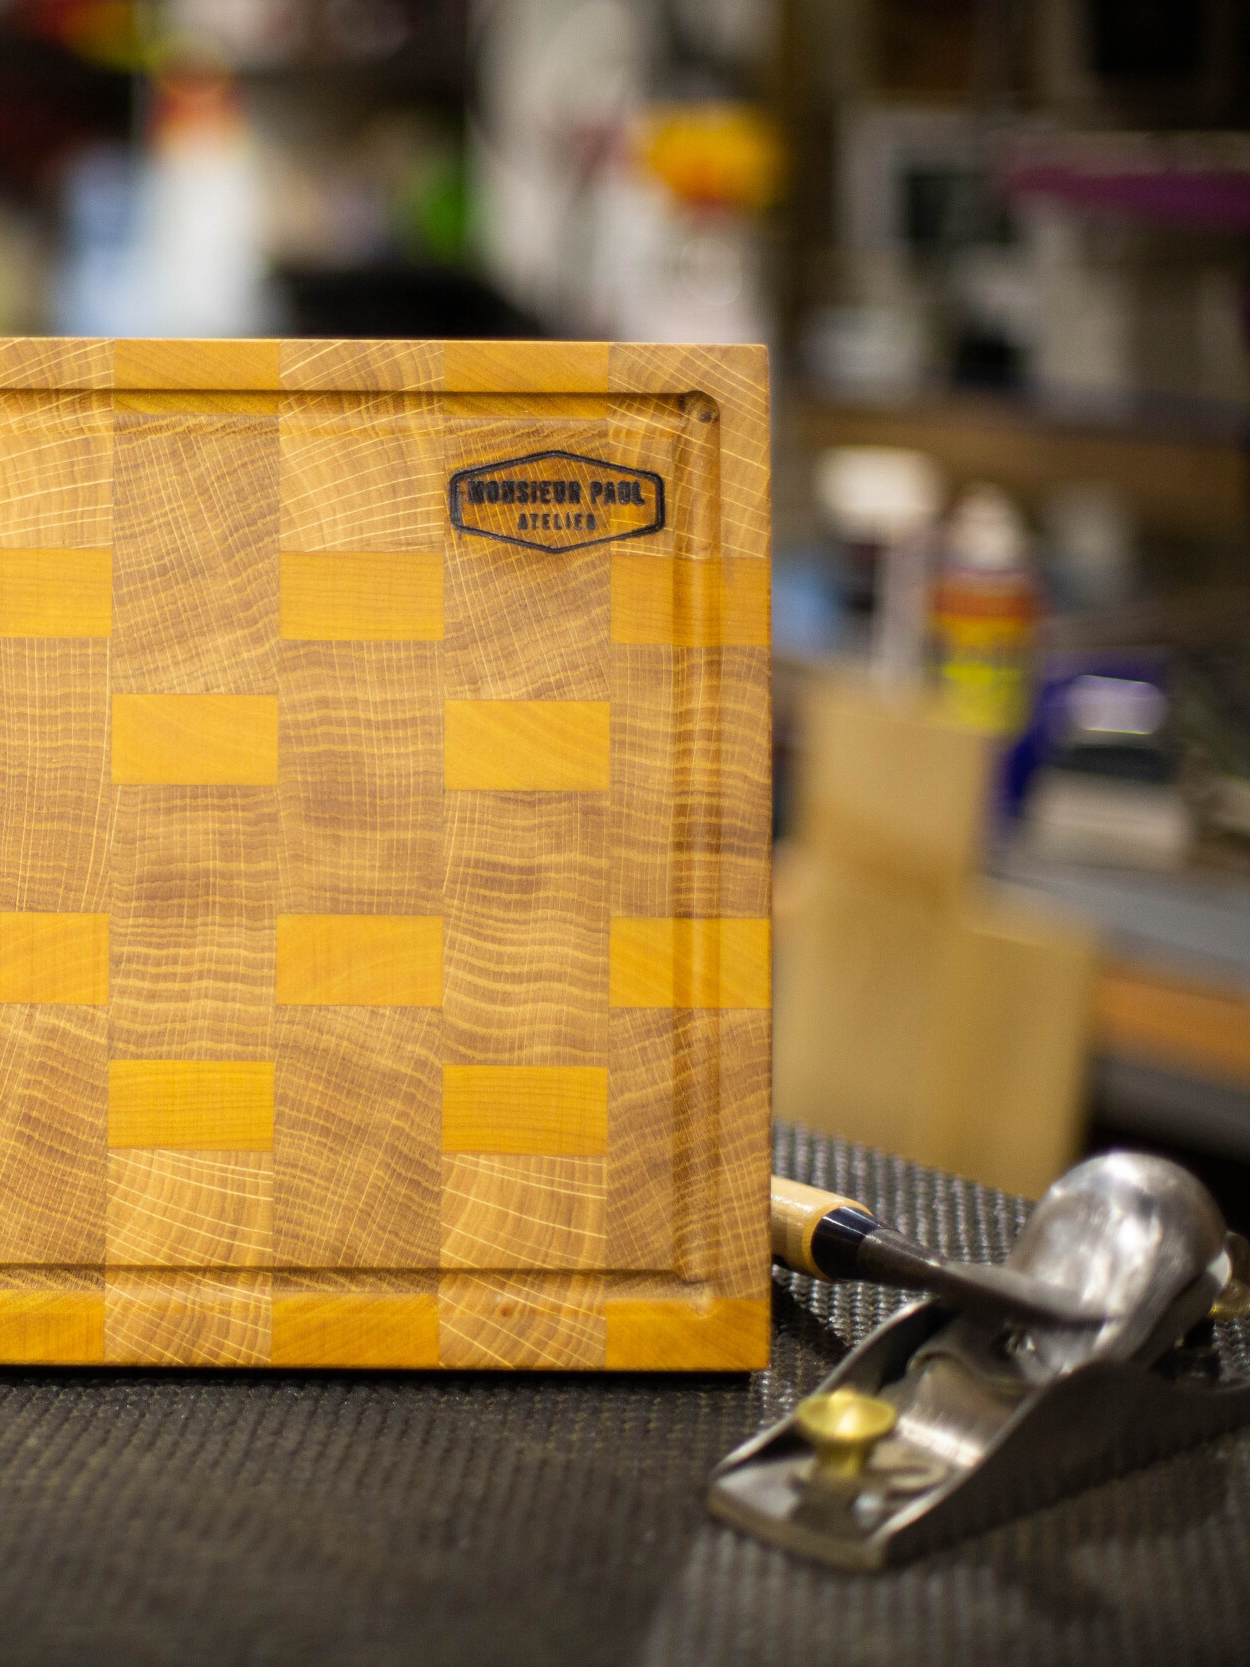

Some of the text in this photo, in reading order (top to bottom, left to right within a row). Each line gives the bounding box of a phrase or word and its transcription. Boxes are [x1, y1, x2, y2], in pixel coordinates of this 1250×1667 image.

[467, 479, 645, 507] MONSIEUR PAUL
[517, 512, 597, 531] ATELIER
